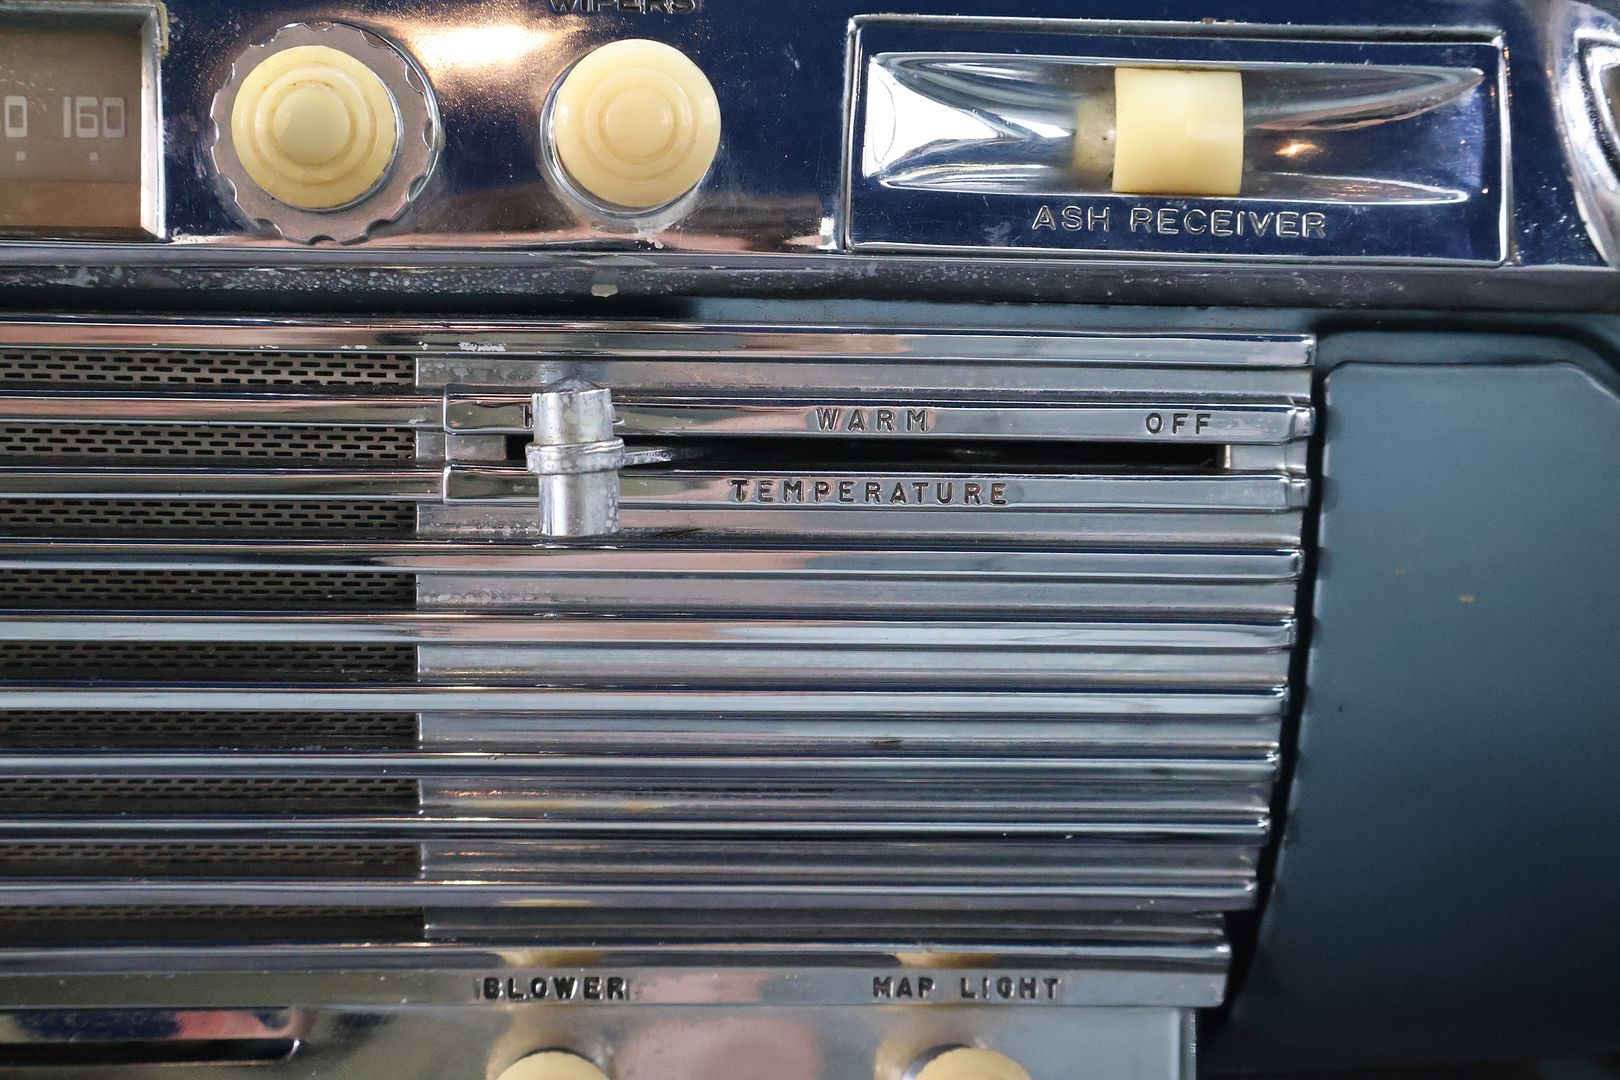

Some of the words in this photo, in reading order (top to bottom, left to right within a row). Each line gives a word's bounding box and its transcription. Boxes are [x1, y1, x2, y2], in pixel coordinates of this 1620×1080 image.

[63, 96, 125, 138] 160
[1031, 205, 1110, 232] ASH
[1129, 207, 1326, 238] RECEIVER
[816, 407, 928, 432] WARM
[1145, 412, 1212, 435] OFF
[730, 478, 1009, 505] TEMPERATURE
[483, 976, 627, 1000] BLOWER
[873, 976, 934, 998] MAP
[960, 977, 1062, 999] LIGHT
